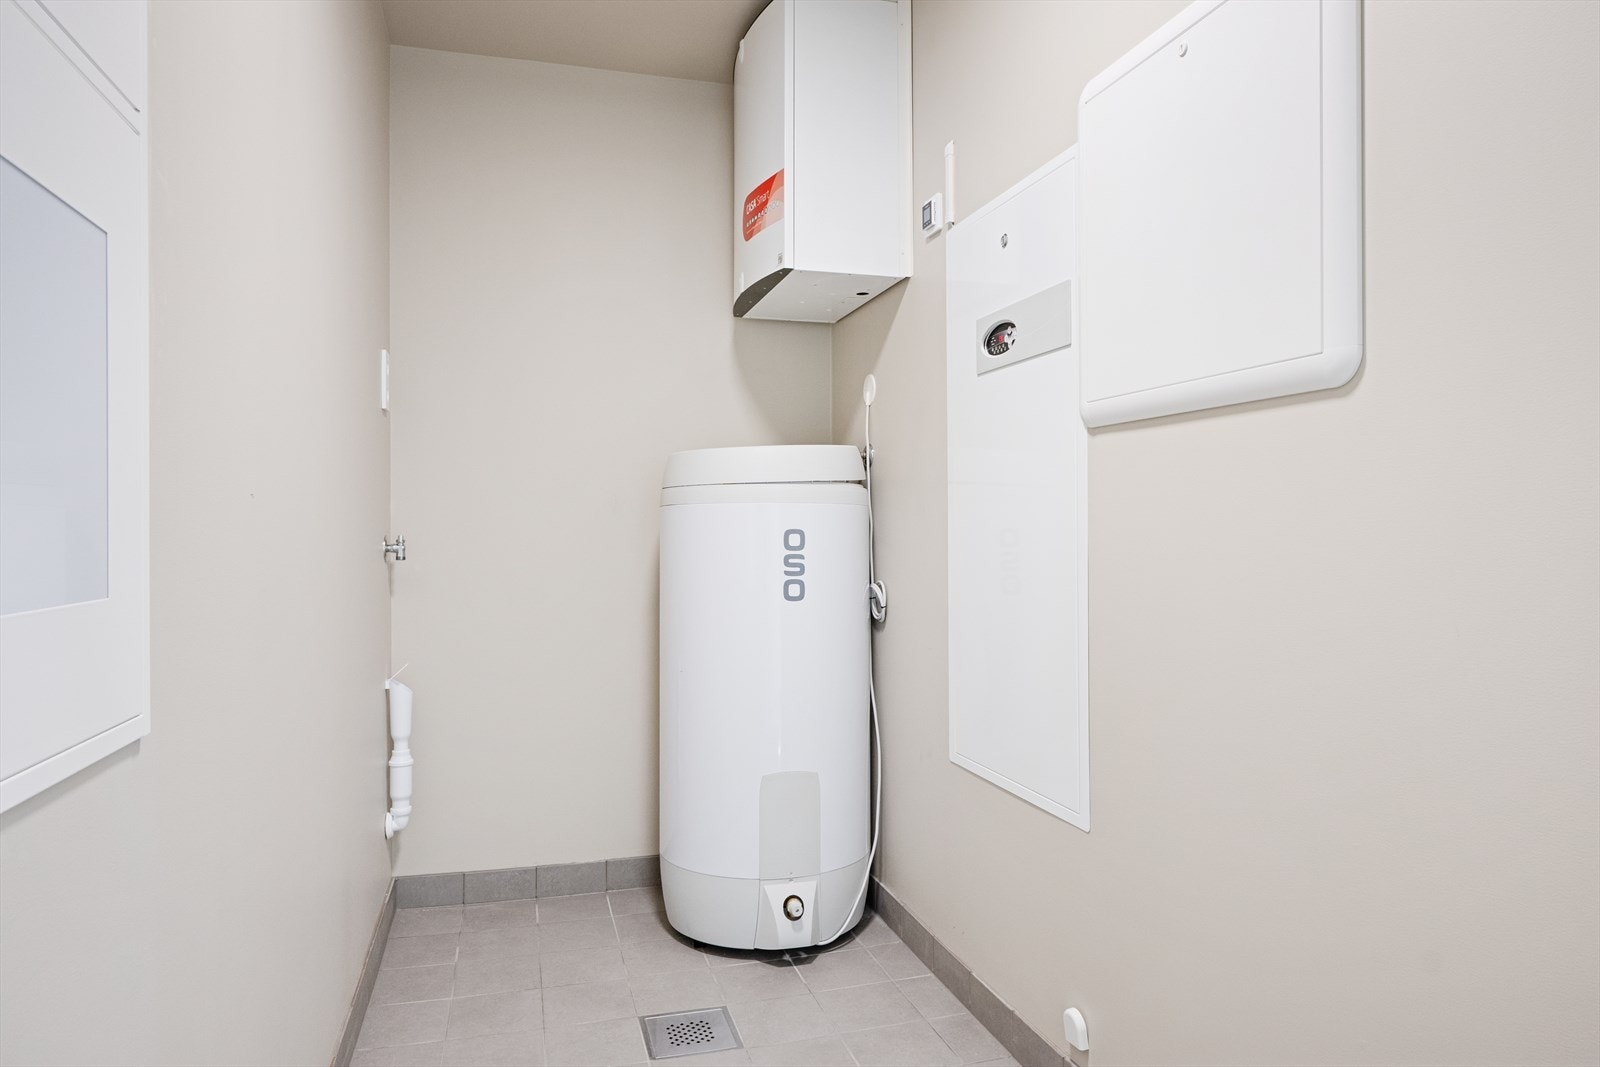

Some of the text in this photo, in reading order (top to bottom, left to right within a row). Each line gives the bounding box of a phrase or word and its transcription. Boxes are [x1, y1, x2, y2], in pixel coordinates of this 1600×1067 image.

[746, 190, 770, 215] CASA Smart
[783, 528, 806, 602] OSO
